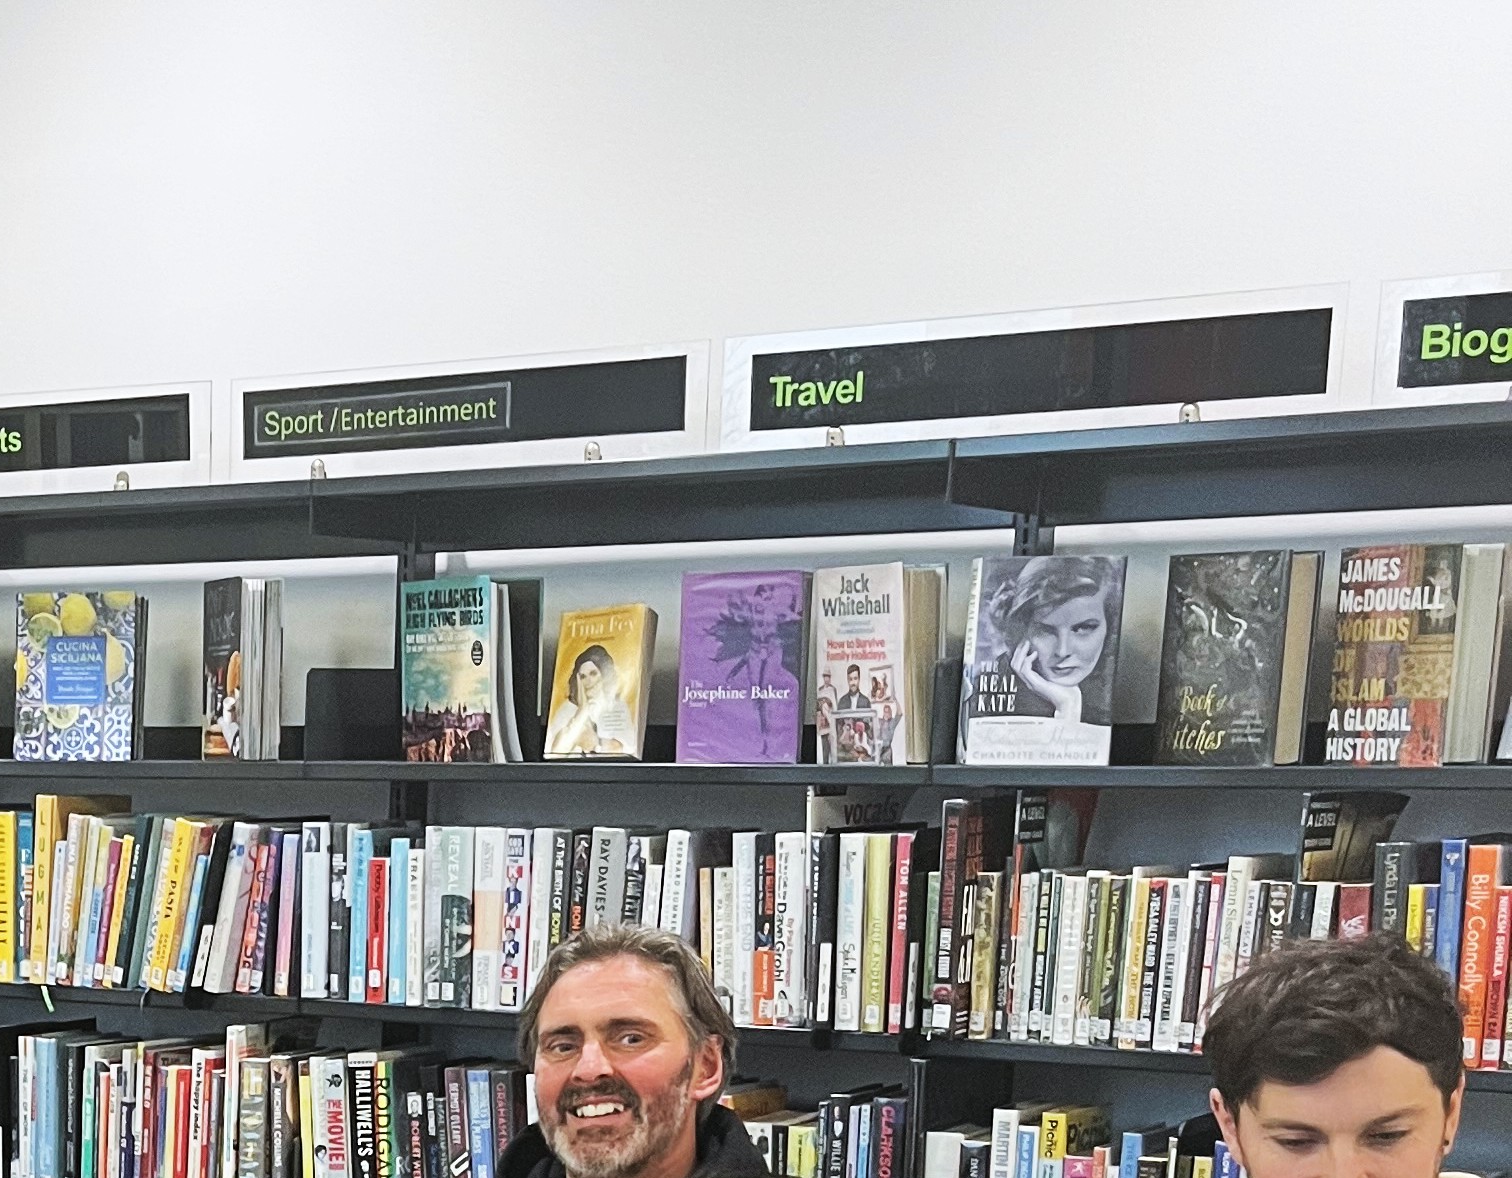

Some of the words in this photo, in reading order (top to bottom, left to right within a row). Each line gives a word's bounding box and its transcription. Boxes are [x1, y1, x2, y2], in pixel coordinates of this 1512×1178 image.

[1421, 322, 1512, 363] Biog
[769, 370, 863, 407] Travel
[264, 409, 324, 440] Sport
[840, 573, 870, 595] Jack
[1341, 557, 1400, 584] JAMES
[822, 594, 890, 617] Whitehall
[1339, 586, 1445, 613] McDOUGALL
[429, 611, 456, 627] FLYING
[460, 609, 484, 626] BIRDS
[569, 618, 604, 638] Tina
[609, 615, 634, 634] Fey
[1339, 617, 1410, 642] WORLDS
[56, 641, 98, 652] CUCINA
[826, 639, 844, 649] How
[846, 639, 854, 649] to
[856, 637, 885, 649] Survive
[683, 685, 747, 702] Josephine
[750, 684, 791, 699] Baker
[979, 674, 1018, 693] REAL
[1331, 677, 1386, 702] ISLAM
[977, 694, 1016, 712] KATE
[1179, 683, 1217, 721] Book
[1327, 708, 1339, 731] A
[1344, 707, 1411, 731] GLOBAL
[972, 750, 1033, 761] CHARLOTTE
[1039, 750, 1098, 760] CHANDLER
[1326, 737, 1401, 761] HISTORY
[68, 819, 78, 862] SHELINA
[557, 837, 565, 848] AT
[599, 839, 611, 863] RAY
[447, 835, 460, 890] REVEAL
[555, 851, 564, 867] THE
[674, 841, 683, 886] BERNARD
[899, 859, 910, 888] TOM
[1385, 853, 1399, 888] Lynda
[62, 865, 74, 929] PERMALLOO
[553, 870, 563, 895] BIRTH
[595, 867, 607, 912] DAVIES
[1227, 869, 1242, 905] Lemn
[1385, 890, 1397, 906] La
[1468, 874, 1489, 909] Billy
[164, 880, 177, 919] PASTA
[552, 897, 561, 910] OF
[670, 891, 680, 932] SUMNER
[897, 890, 907, 930] ALLEN
[1245, 889, 1255, 918] LEMN
[1496, 896, 1508, 933] NIKESH
[550, 912, 561, 944] BOWIE
[786, 930, 794, 948] Paul
[872, 917, 880, 945] JULIE
[1222, 908, 1237, 948] Sissay
[774, 941, 785, 982] Grohl
[1461, 916, 1485, 993] Connolly
[1492, 936, 1505, 976] SHUKLA
[997, 965, 1007, 1006] APOLOGY
[1490, 980, 1500, 1018] BROWN
[193, 1081, 201, 1110] happy
[273, 1088, 283, 1128] MICHELLE
[449, 1083, 460, 1112] DERMOT
[496, 1082, 507, 1135] GRAHAM
[355, 1070, 373, 1156] HALLIWELL'S
[327, 1111, 345, 1162] MOVIE
[411, 1121, 421, 1158] ROBERT
[451, 1115, 461, 1145] O'LEARY
[995, 1121, 1011, 1166] MARTIN
[1044, 1120, 1059, 1158] Picnic
[274, 1131, 282, 1167] COLLINS
[830, 1140, 843, 1171] WILLIE
[970, 1158, 979, 1176] DAN
